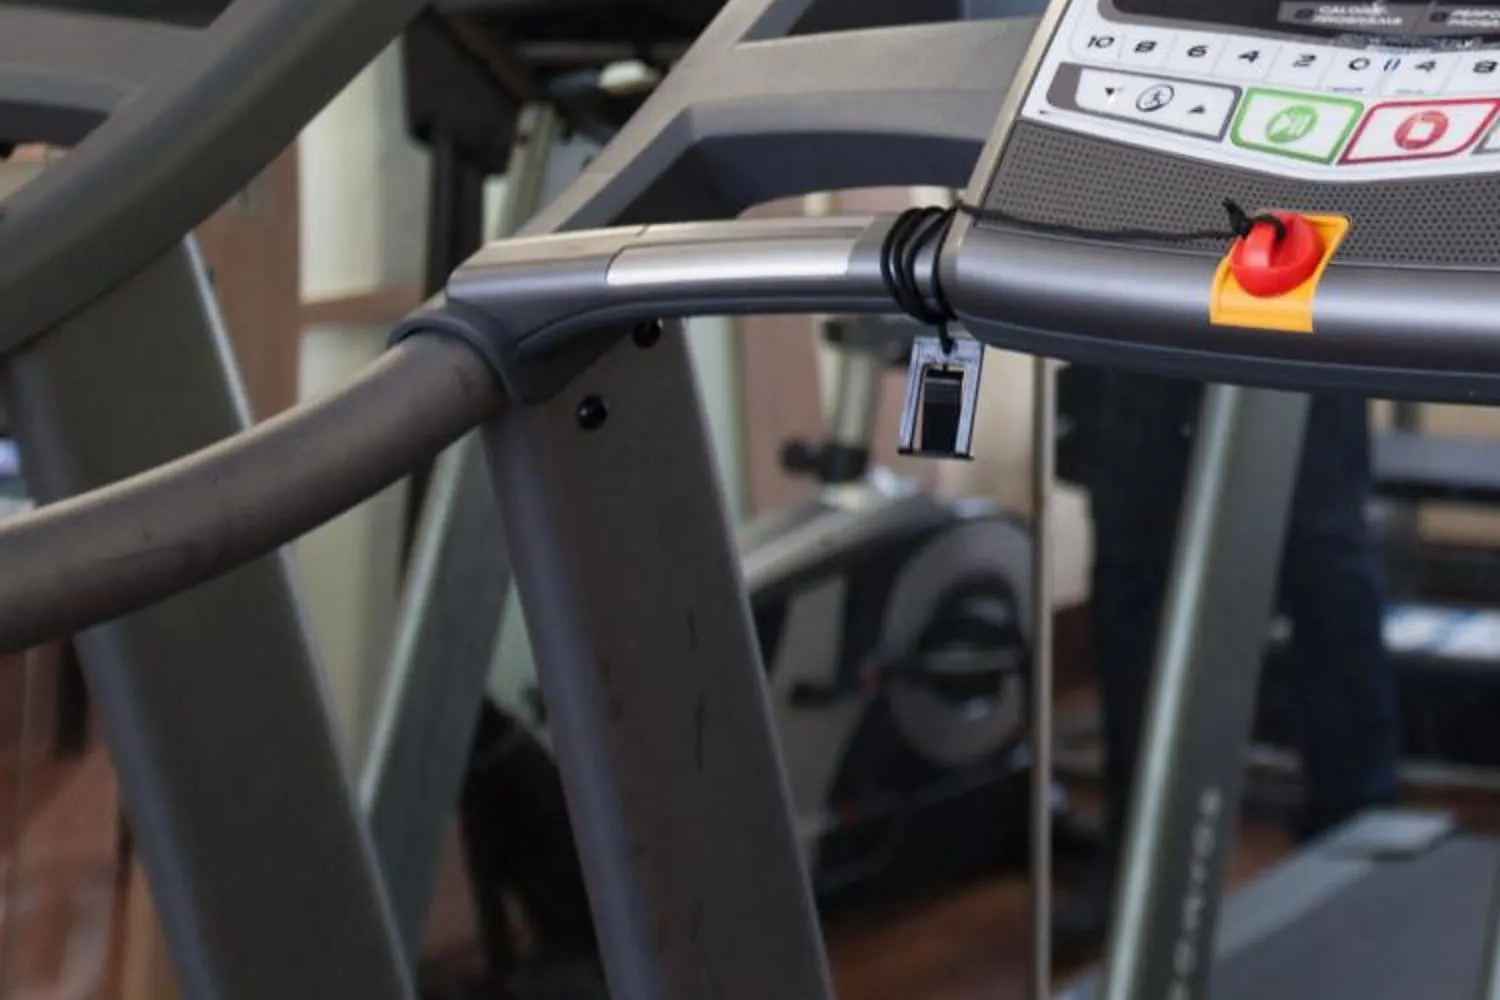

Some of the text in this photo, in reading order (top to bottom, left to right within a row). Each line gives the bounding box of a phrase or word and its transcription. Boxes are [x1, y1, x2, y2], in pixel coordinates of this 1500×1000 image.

[1086, 35, 1372, 72] 10 8 6 4 2 0
[1415, 59, 1438, 74] 4
[1471, 60, 1499, 74] 8
